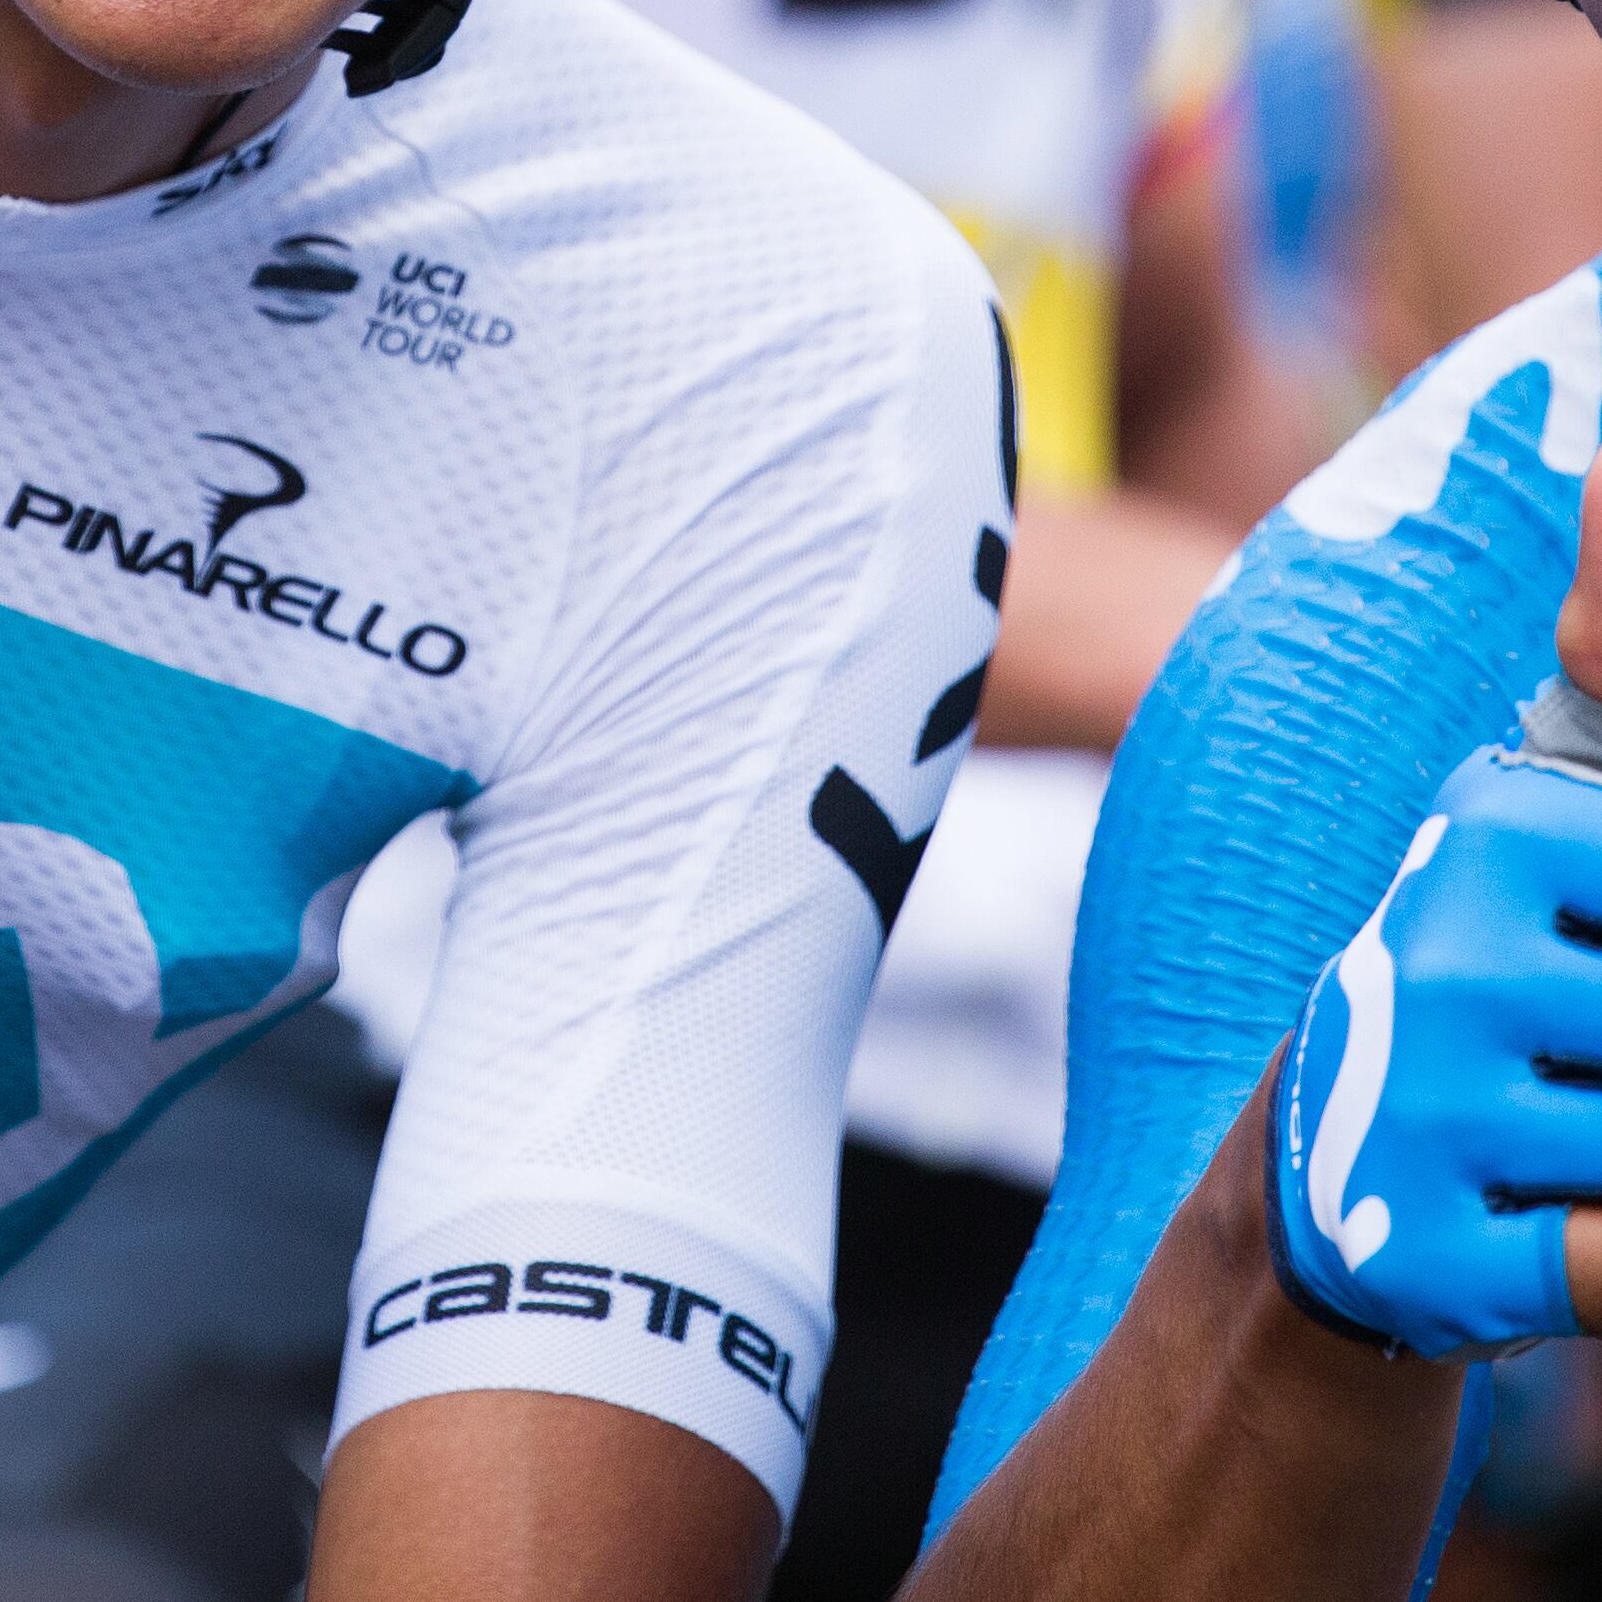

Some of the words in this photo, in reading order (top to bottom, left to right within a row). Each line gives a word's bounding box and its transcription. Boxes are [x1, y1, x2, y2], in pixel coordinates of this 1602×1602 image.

[392, 252, 468, 299] UCI
[361, 317, 466, 374] TOUR
[375, 287, 517, 349] WORLD
[2, 482, 468, 678] PINARELLO
